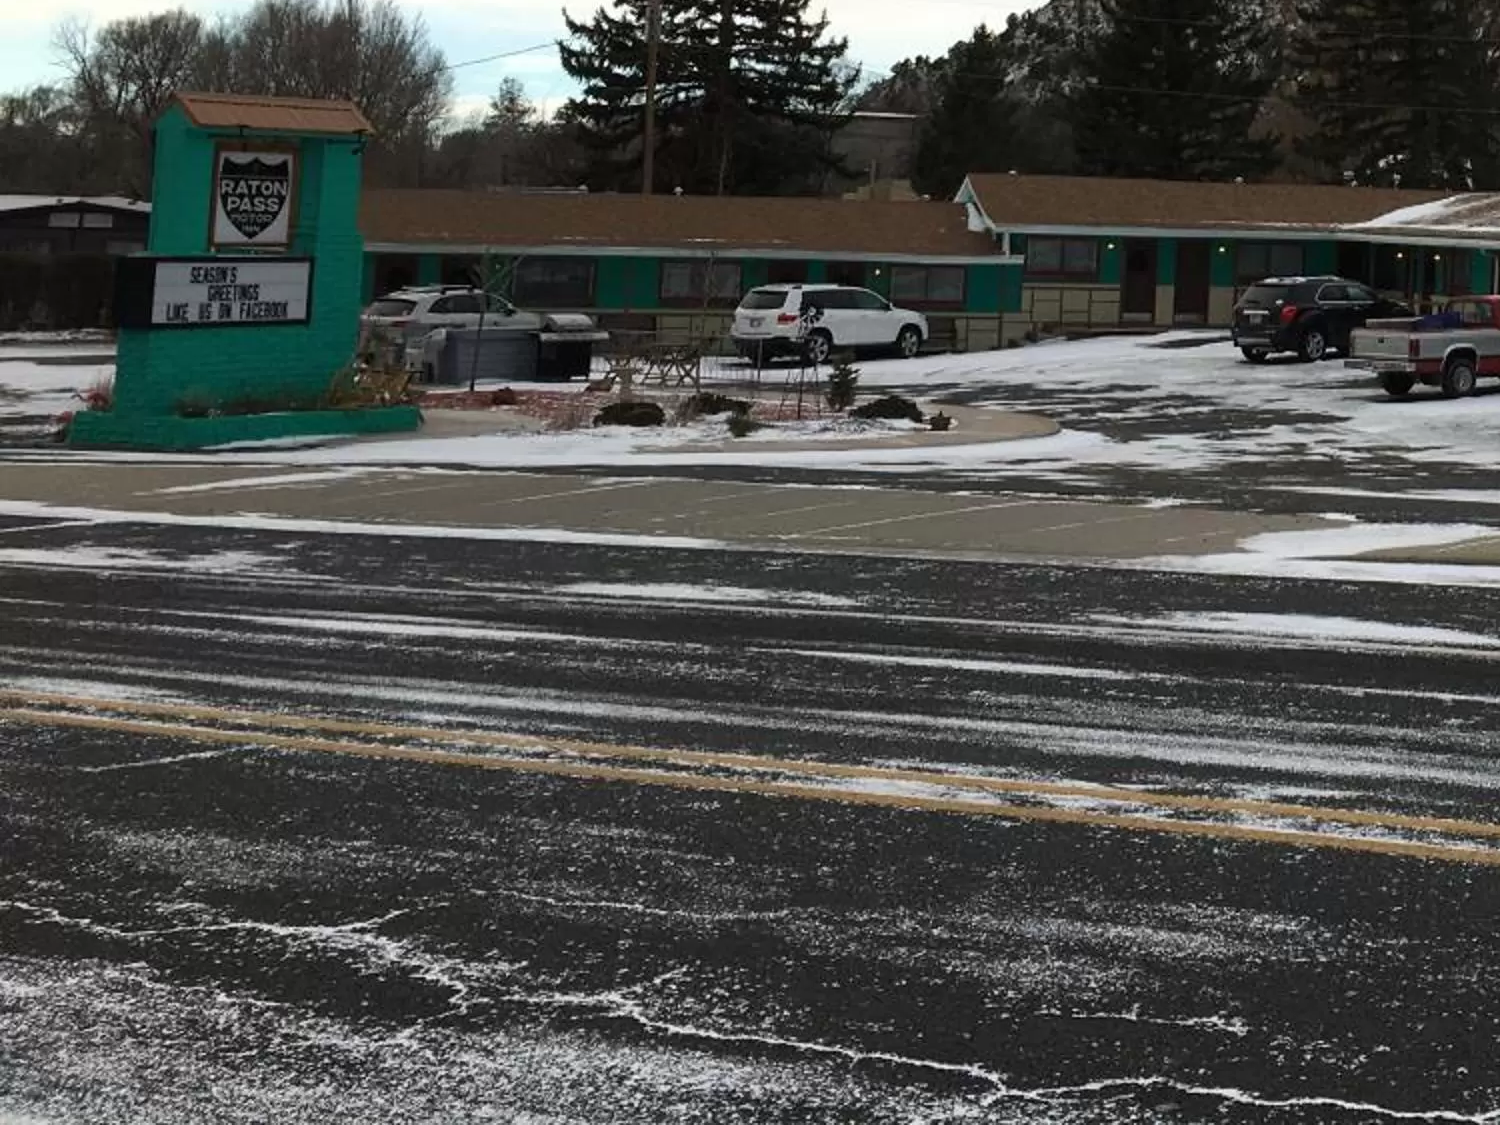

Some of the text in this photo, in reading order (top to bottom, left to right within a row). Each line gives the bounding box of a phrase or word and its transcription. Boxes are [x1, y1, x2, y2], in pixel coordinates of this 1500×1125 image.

[221, 179, 287, 196] RATON
[226, 196, 280, 212] PASS
[189, 266, 238, 284] SEASON'S
[207, 284, 260, 302] GREETINGS
[166, 300, 289, 322] LIKE US ON FACEBOOK
